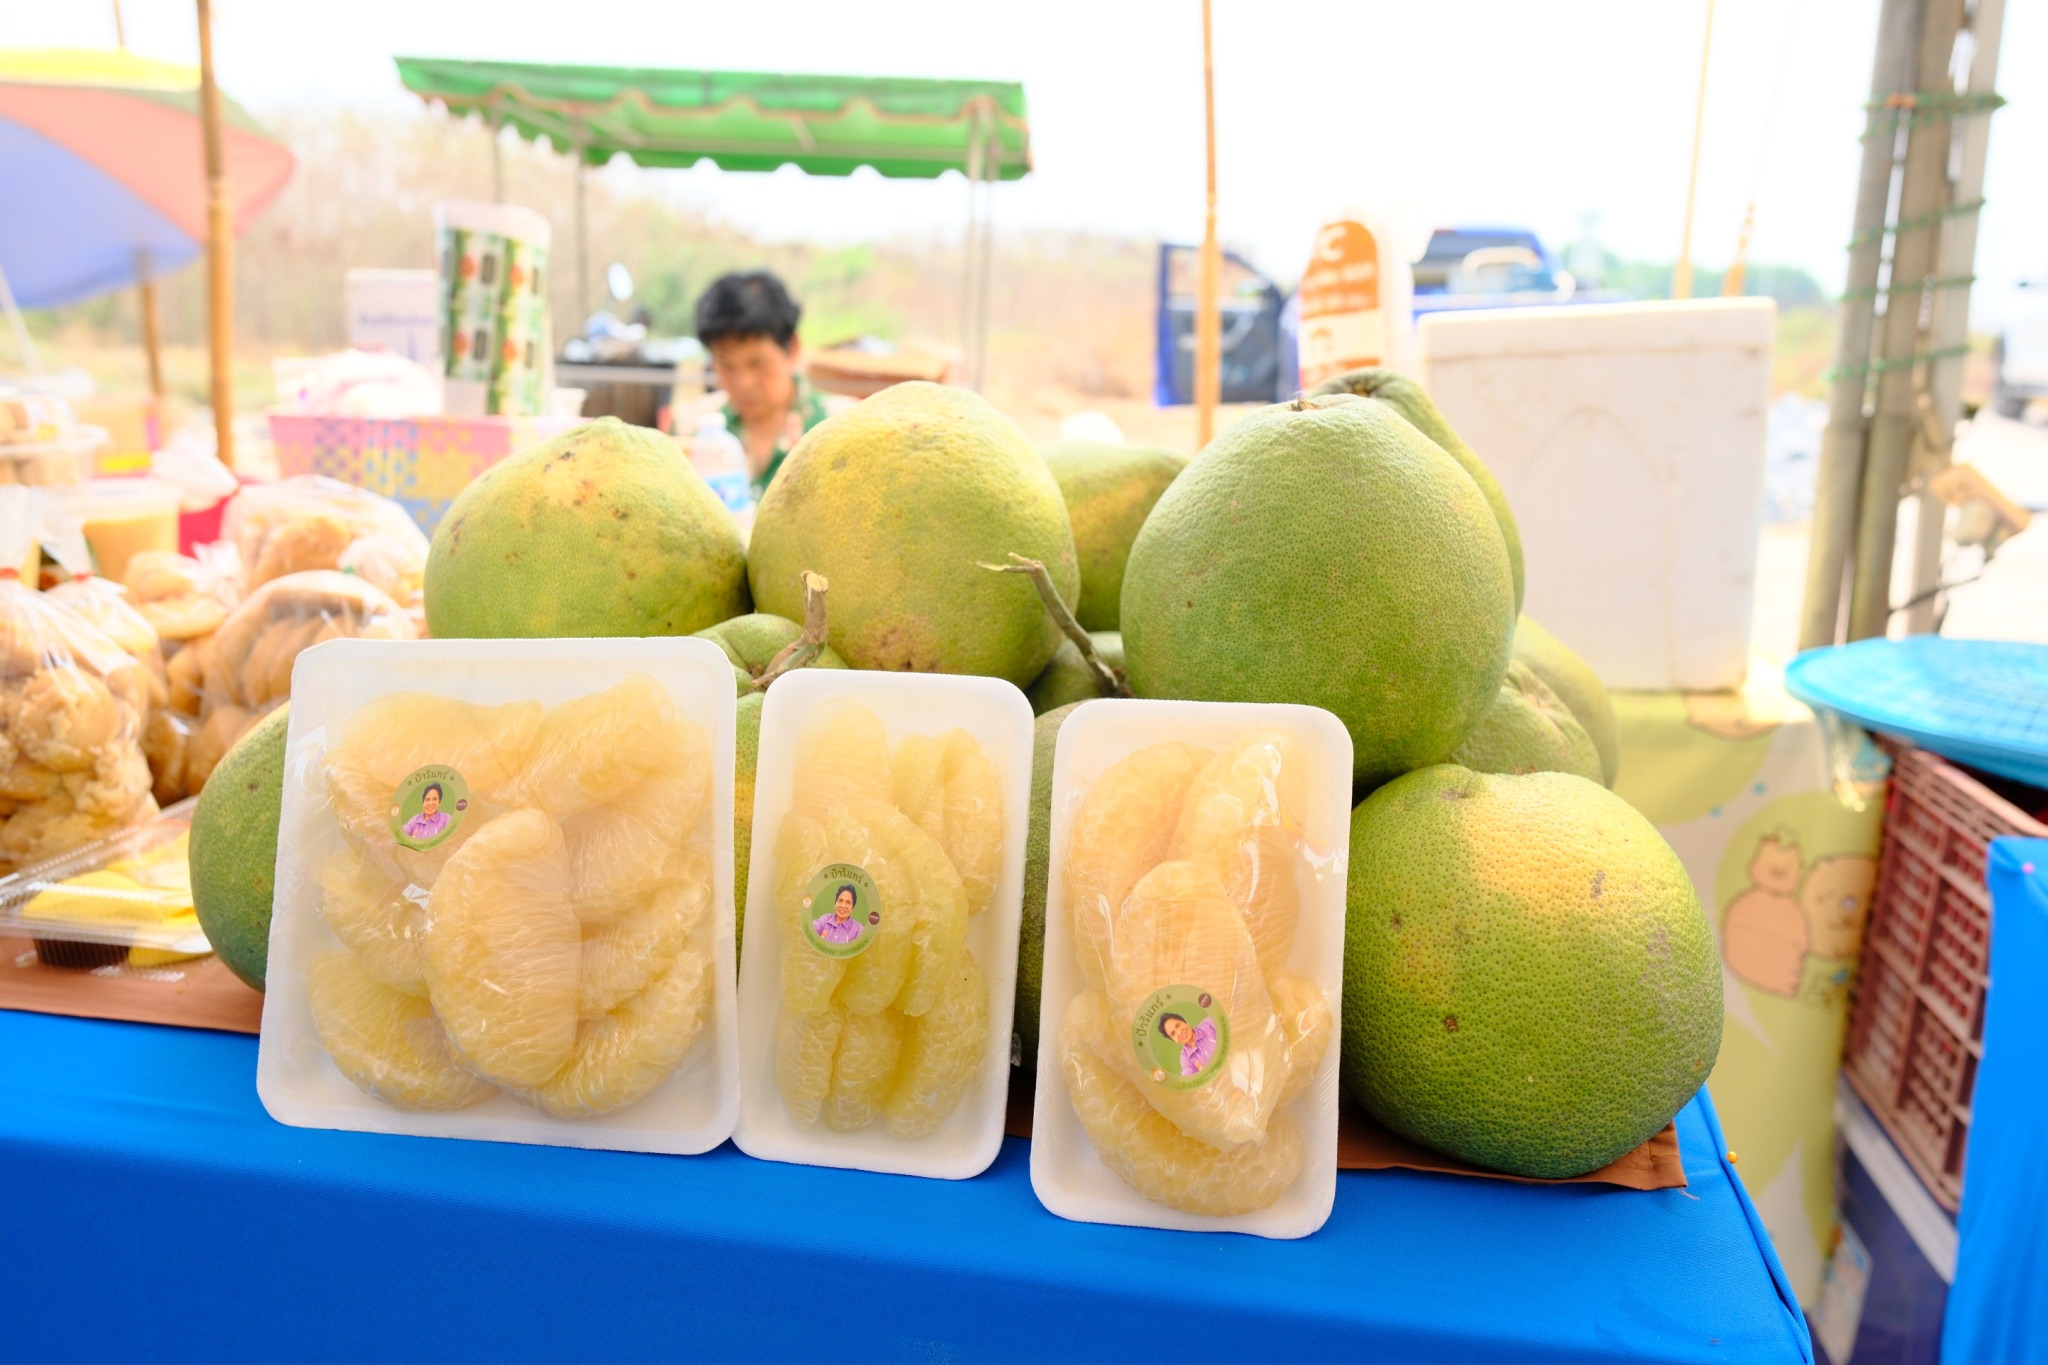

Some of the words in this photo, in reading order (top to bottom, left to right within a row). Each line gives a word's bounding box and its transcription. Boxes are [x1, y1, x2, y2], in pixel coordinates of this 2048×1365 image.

[415, 769, 450, 783] ป้ารินทร์
[831, 867, 865, 884] ป้ารินทร์
[1135, 995, 1165, 1038] ป้ารินทร์
